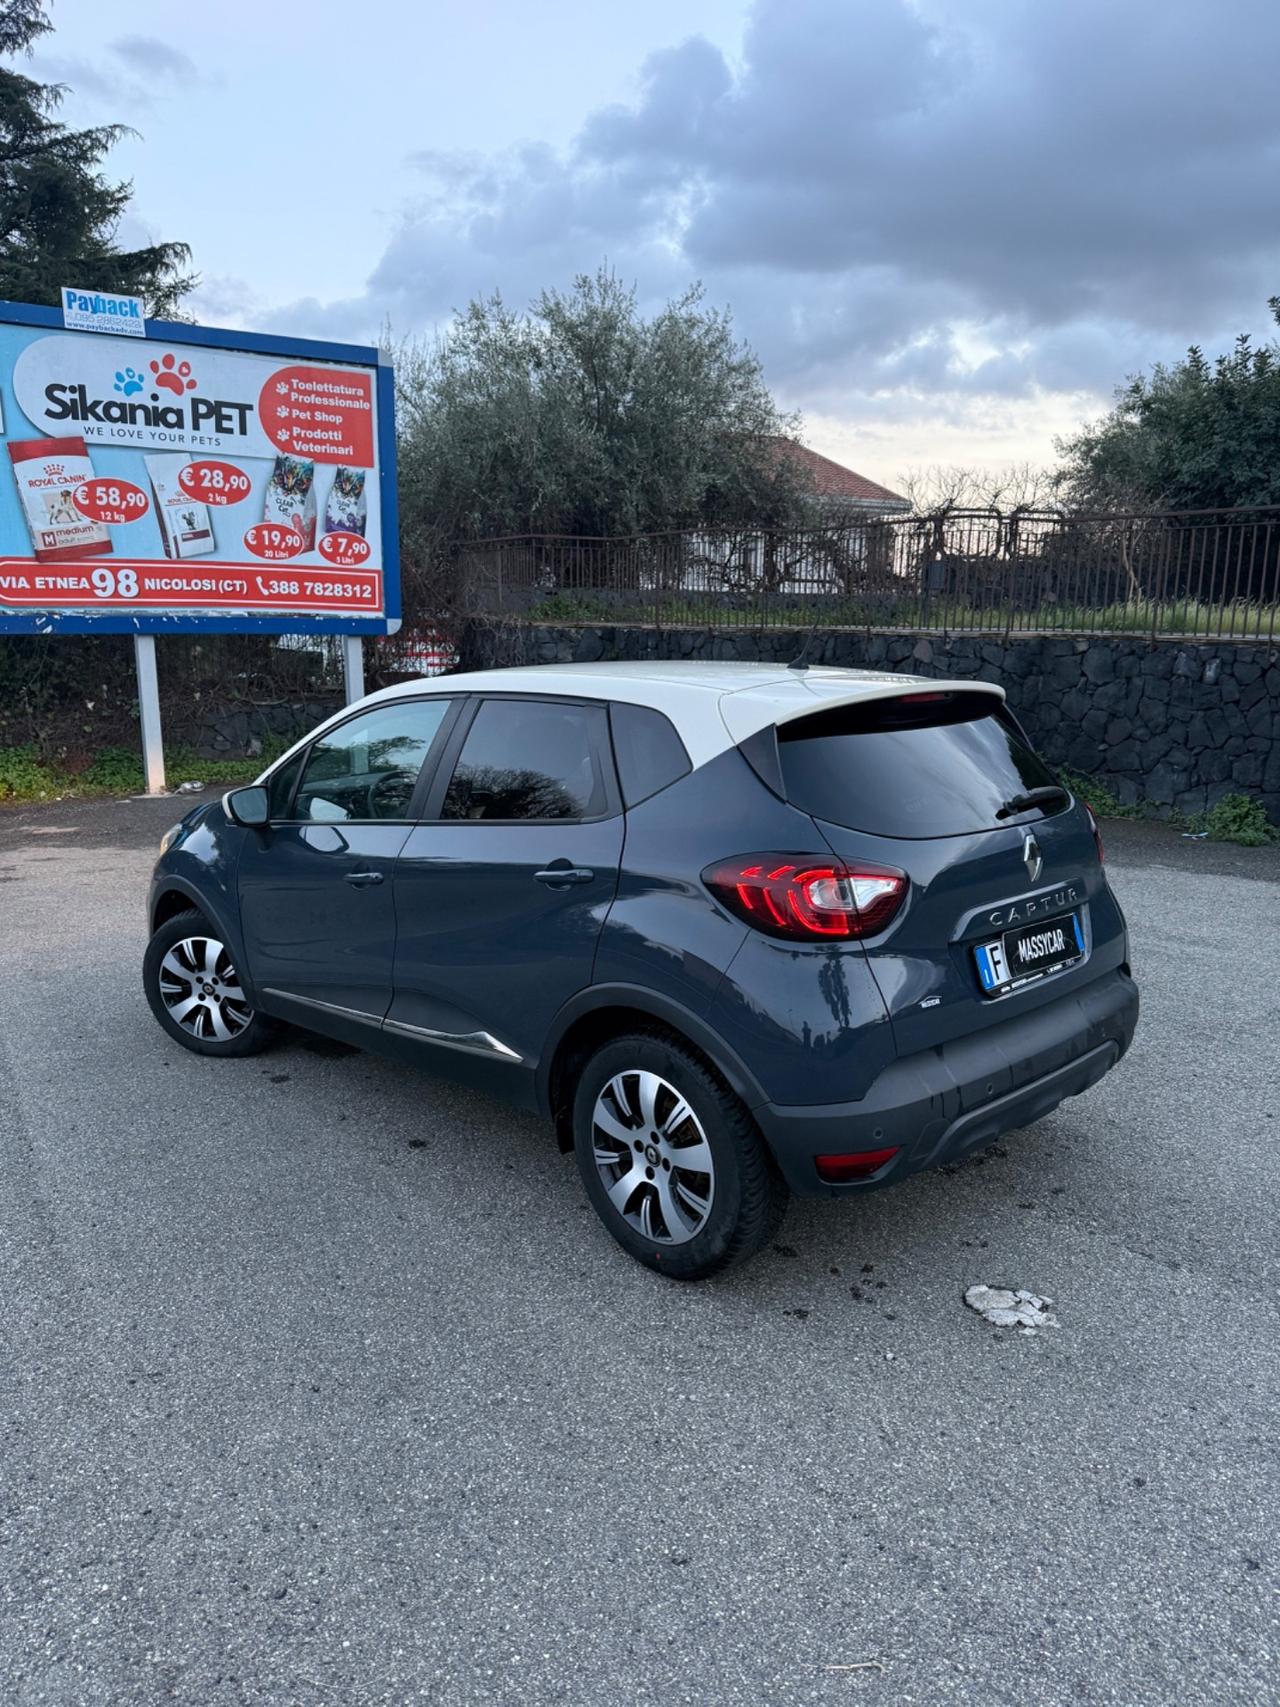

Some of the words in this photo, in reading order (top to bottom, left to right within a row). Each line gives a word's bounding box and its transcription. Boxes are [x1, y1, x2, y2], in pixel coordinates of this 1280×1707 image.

[66, 291, 140, 318] Payback
[291, 379, 364, 396] Toelettatura
[44, 383, 185, 430] Sikania
[190, 397, 254, 436] PET
[290, 392, 370, 410] Professionale
[291, 409, 311, 420] Pet
[314, 411, 343, 425] Shop
[83, 426, 104, 436] WE
[110, 428, 144, 440] LOVE
[150, 432, 185, 444] YOUR
[191, 435, 221, 446] PETS
[292, 426, 342, 441] Prodotti
[292, 440, 354, 456] Veterinari
[28, 478, 57, 488] ROYAL
[57, 475, 86, 485] CANIN
[181, 467, 195, 487] €
[200, 468, 248, 492] 28,90
[75, 486, 89, 505] €
[96, 486, 145, 512] 58,90
[207, 493, 213, 502] 2
[215, 493, 227, 505] kg
[100, 511, 112, 520] 12
[113, 511, 126, 524] kg
[44, 533, 55, 545] M
[55, 525, 94, 537] medium
[246, 530, 257, 545] €
[262, 530, 300, 549] 19,90
[264, 550, 273, 558] 20
[322, 537, 333, 552] €
[337, 538, 367, 556] 7,90
[0, 576, 30, 589] VIA
[34, 577, 91, 590] ETNEA
[91, 568, 139, 598] 98
[144, 578, 216, 591] NICOLOSI
[218, 580, 247, 594] (CT)
[269, 580, 299, 595] 388
[303, 582, 372, 598] 7828312
[989, 888, 1078, 926] CAPTUR
[1017, 928, 1066, 963] MASSYCAR
